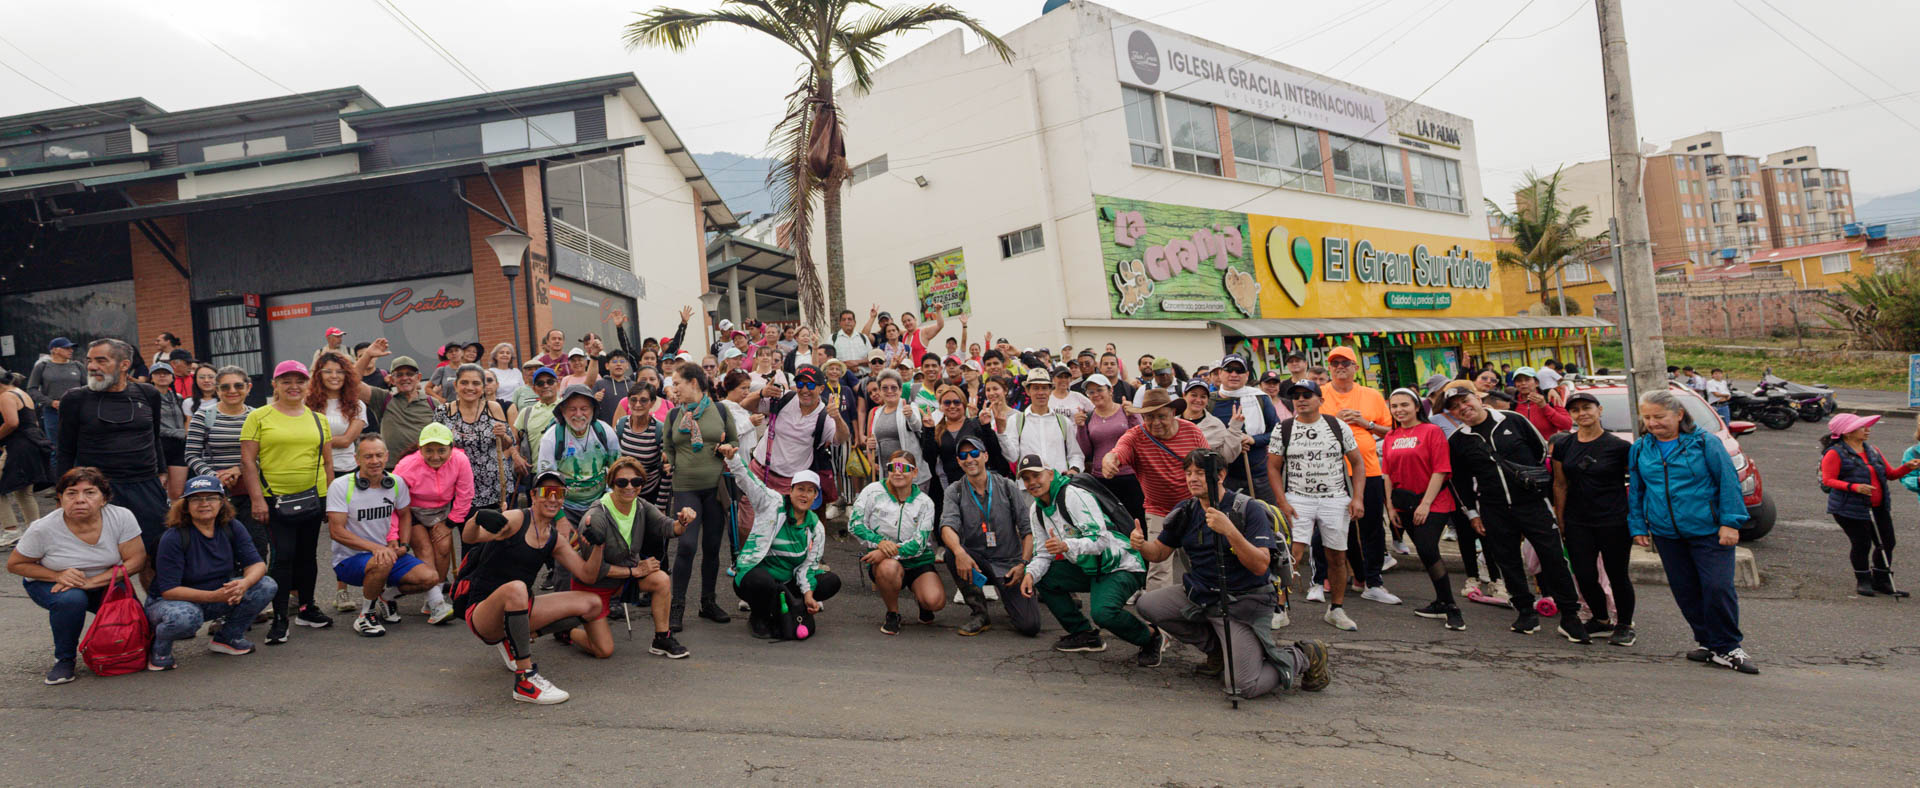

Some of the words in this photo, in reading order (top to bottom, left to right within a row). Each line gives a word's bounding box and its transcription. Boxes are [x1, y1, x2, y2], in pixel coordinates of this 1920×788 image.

[1167, 49, 1226, 84] IGLESIA
[1228, 67, 1283, 99] GRACIA
[1284, 82, 1377, 123] INTERNACIONAL
[1417, 119, 1430, 137] LA
[1430, 123, 1461, 145] PALMA
[1322, 236, 1350, 282] El
[1354, 239, 1412, 285] Gran
[1413, 244, 1492, 289] Surtidor
[379, 287, 464, 323] Creativa
[1391, 294, 1412, 305] Calidad
[1391, 436, 1418, 449] STRONG
[357, 504, 392, 521] PUMA
